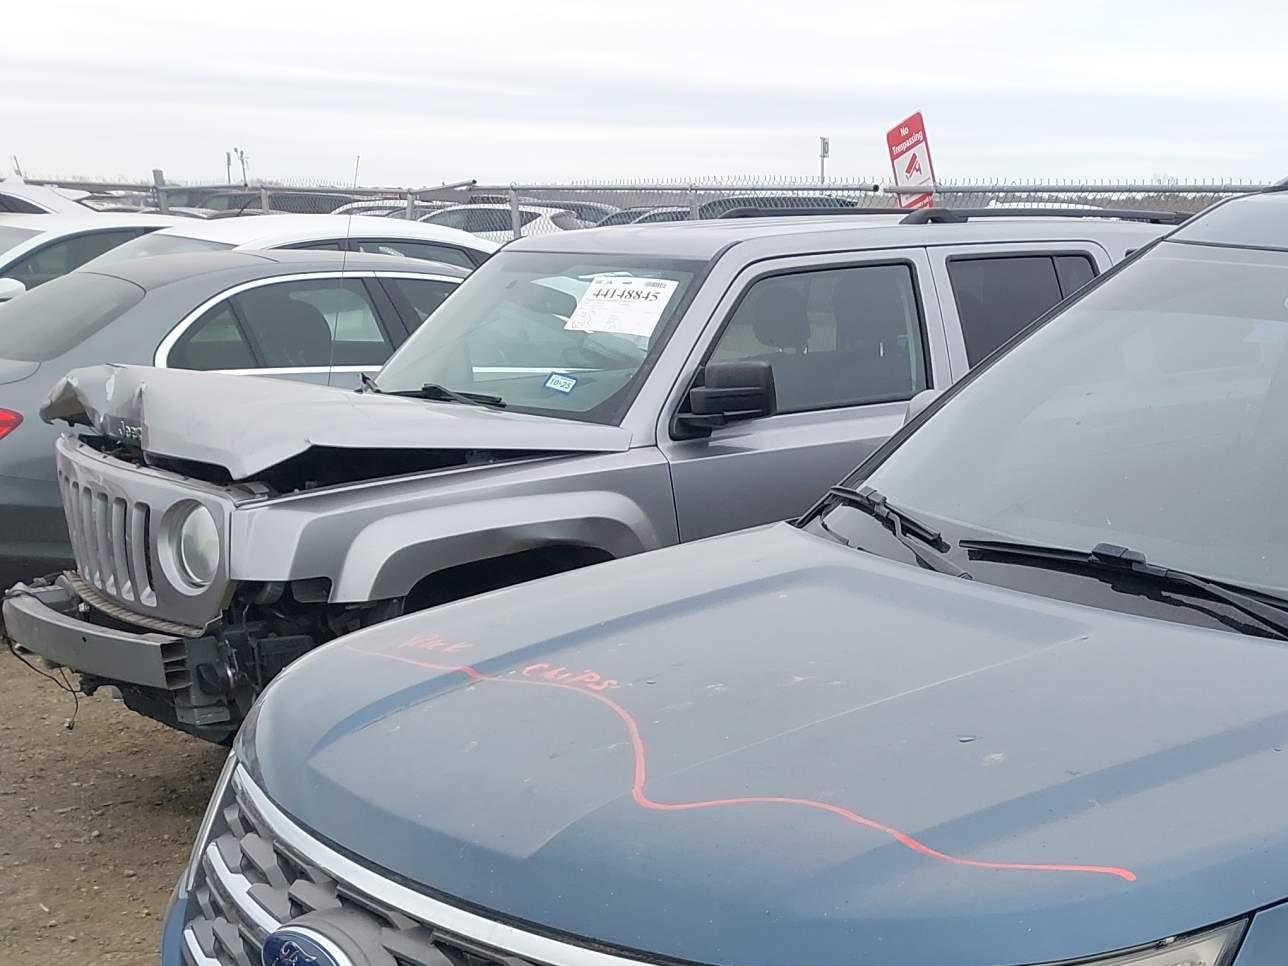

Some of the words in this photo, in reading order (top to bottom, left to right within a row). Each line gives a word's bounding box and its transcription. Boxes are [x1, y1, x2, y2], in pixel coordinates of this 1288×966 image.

[900, 127, 909, 137] No
[892, 131, 923, 155] Trespassing
[592, 288, 661, 302] 44148845
